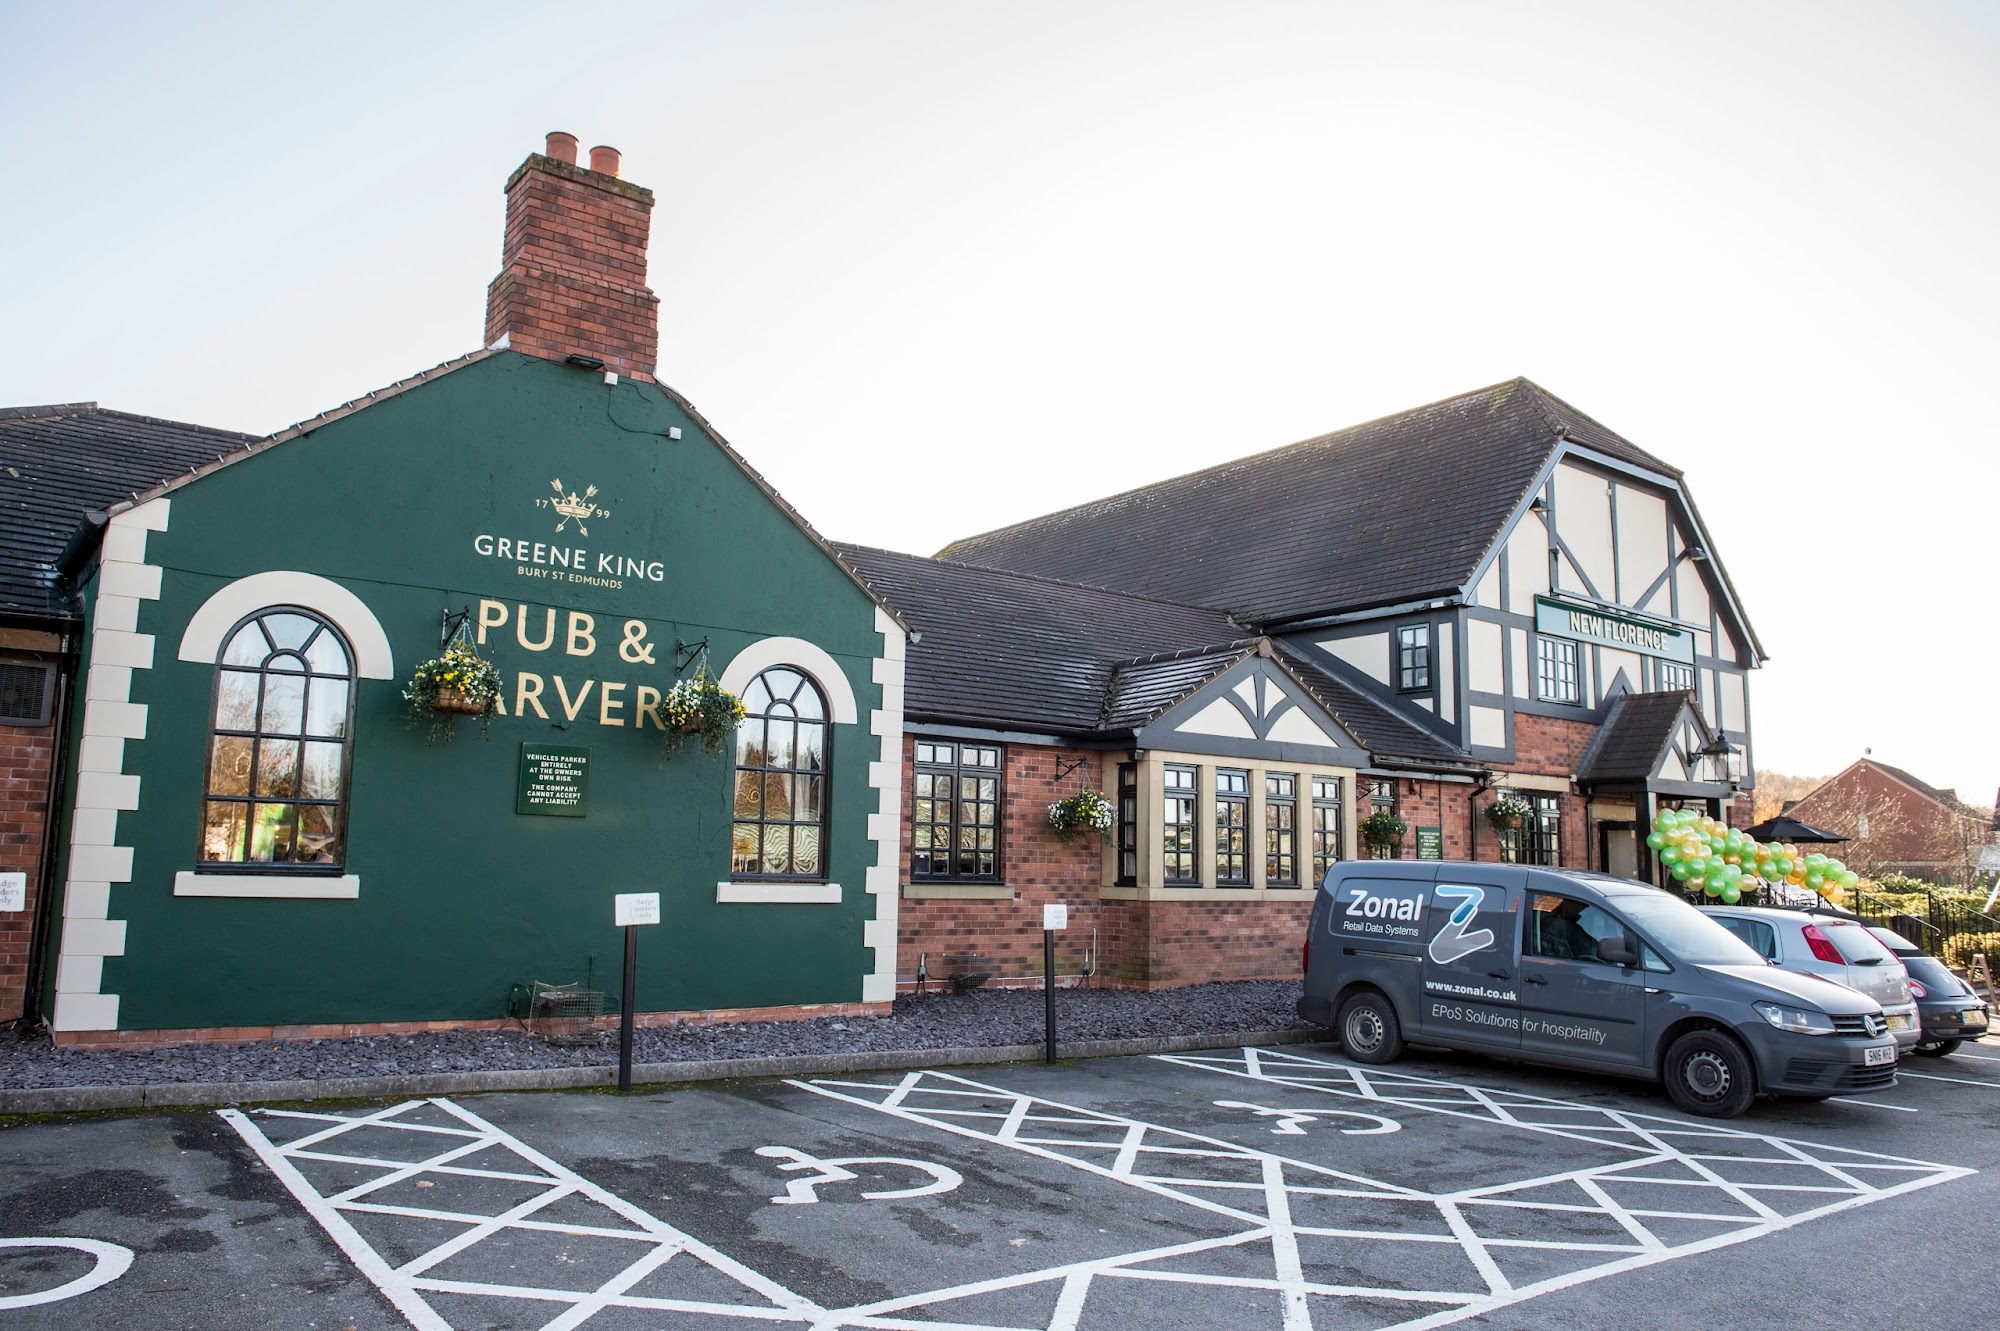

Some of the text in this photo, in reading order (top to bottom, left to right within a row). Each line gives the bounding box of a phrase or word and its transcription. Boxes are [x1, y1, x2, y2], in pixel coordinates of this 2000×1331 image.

[535, 499, 610, 519] 17 99
[474, 534, 664, 582] GREENE KING
[517, 566, 623, 590] BURY ST EDMUNDS
[477, 599, 656, 665] PUB &
[1569, 611, 1669, 651] NEW FLORENCE
[540, 761, 573, 769] ENTIRELY
[560, 756, 587, 764] PARKED
[0, 880, 18, 888] dge
[1345, 889, 1424, 921] Zonal
[1343, 920, 1419, 937] Retail Data Systems
[1426, 981, 1517, 1001] www.zonal.co.uk
[1432, 1004, 1607, 1046] EPoS Solutions for hospitality
